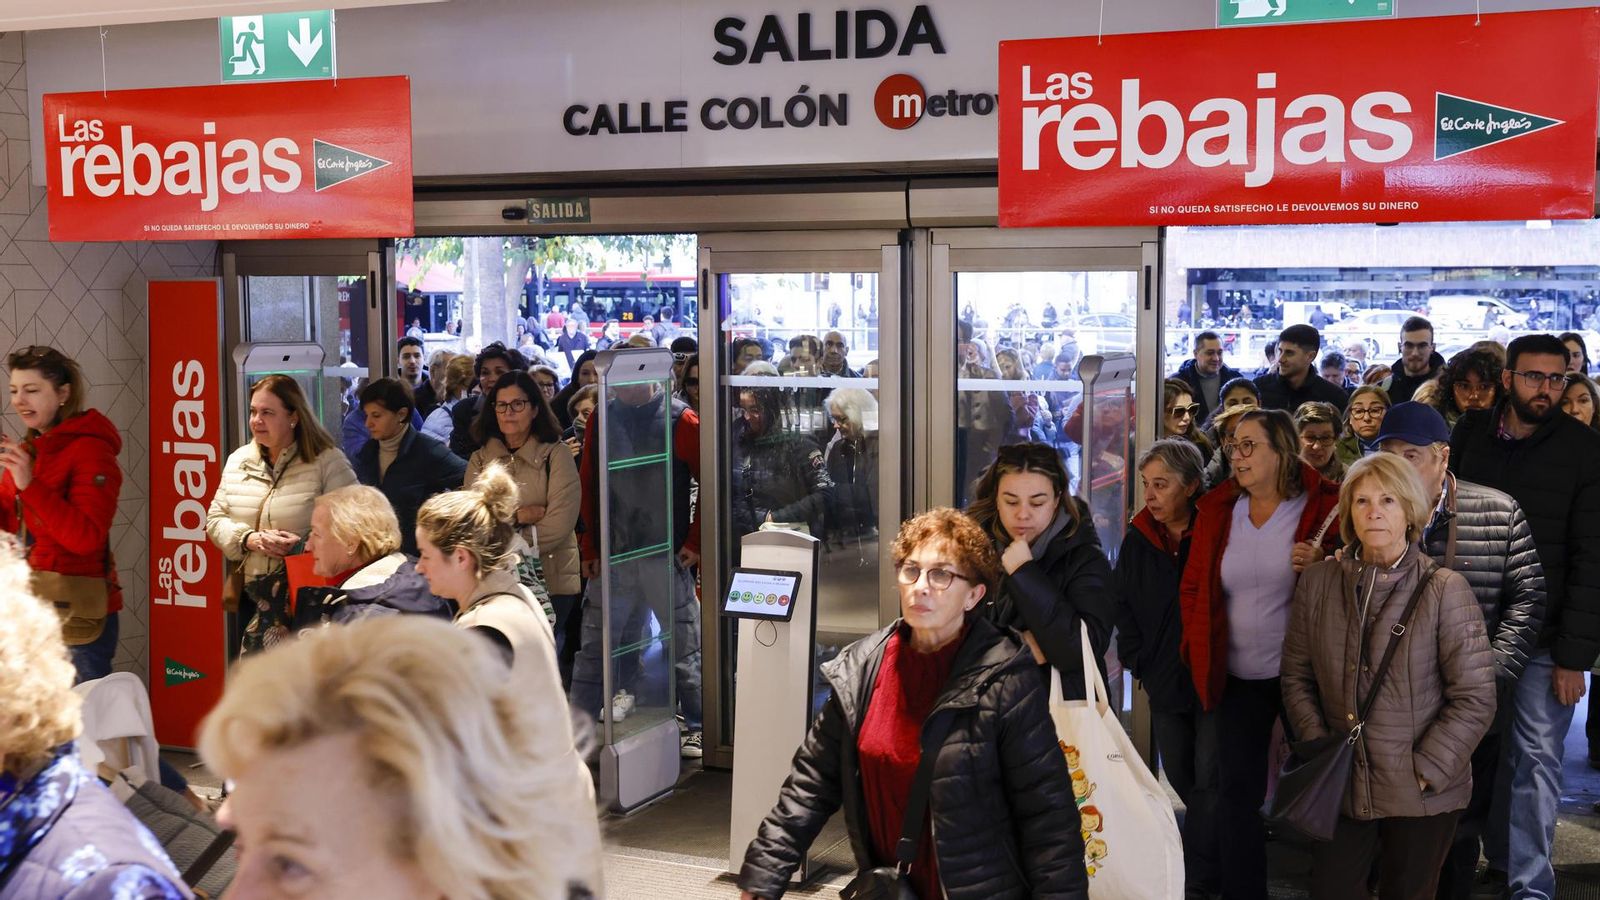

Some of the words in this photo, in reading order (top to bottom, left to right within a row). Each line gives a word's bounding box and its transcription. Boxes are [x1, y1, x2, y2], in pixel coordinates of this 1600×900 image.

[712, 5, 947, 66] SALIDA
[1022, 65, 1093, 101] Las
[562, 101, 688, 136] CALLE
[700, 85, 848, 131] COLÓN
[893, 89, 998, 118] metro
[58, 114, 104, 142] Las
[1022, 73, 1414, 188] rebajas
[1440, 117, 1454, 130] El
[1454, 117, 1485, 130] Corte
[1486, 113, 1532, 135] Inglés
[59, 121, 302, 212] rebajas
[317, 158, 326, 168] El
[326, 158, 344, 168] Corte
[532, 202, 584, 218] SALIDA
[1149, 206, 1158, 214] SI
[1161, 205, 1175, 214] NO
[1178, 205, 1210, 213] QUEDA
[1213, 204, 1274, 213] SATISFECHO
[1277, 203, 1289, 212] LE
[1292, 203, 1360, 212] DEVOLVEMOS
[1362, 202, 1376, 210] SU
[1379, 201, 1419, 210] DINERO
[222, 223, 231, 231] LE
[285, 222, 310, 230] DINERO
[162, 359, 217, 608] rebajas
[154, 557, 173, 606] Las
